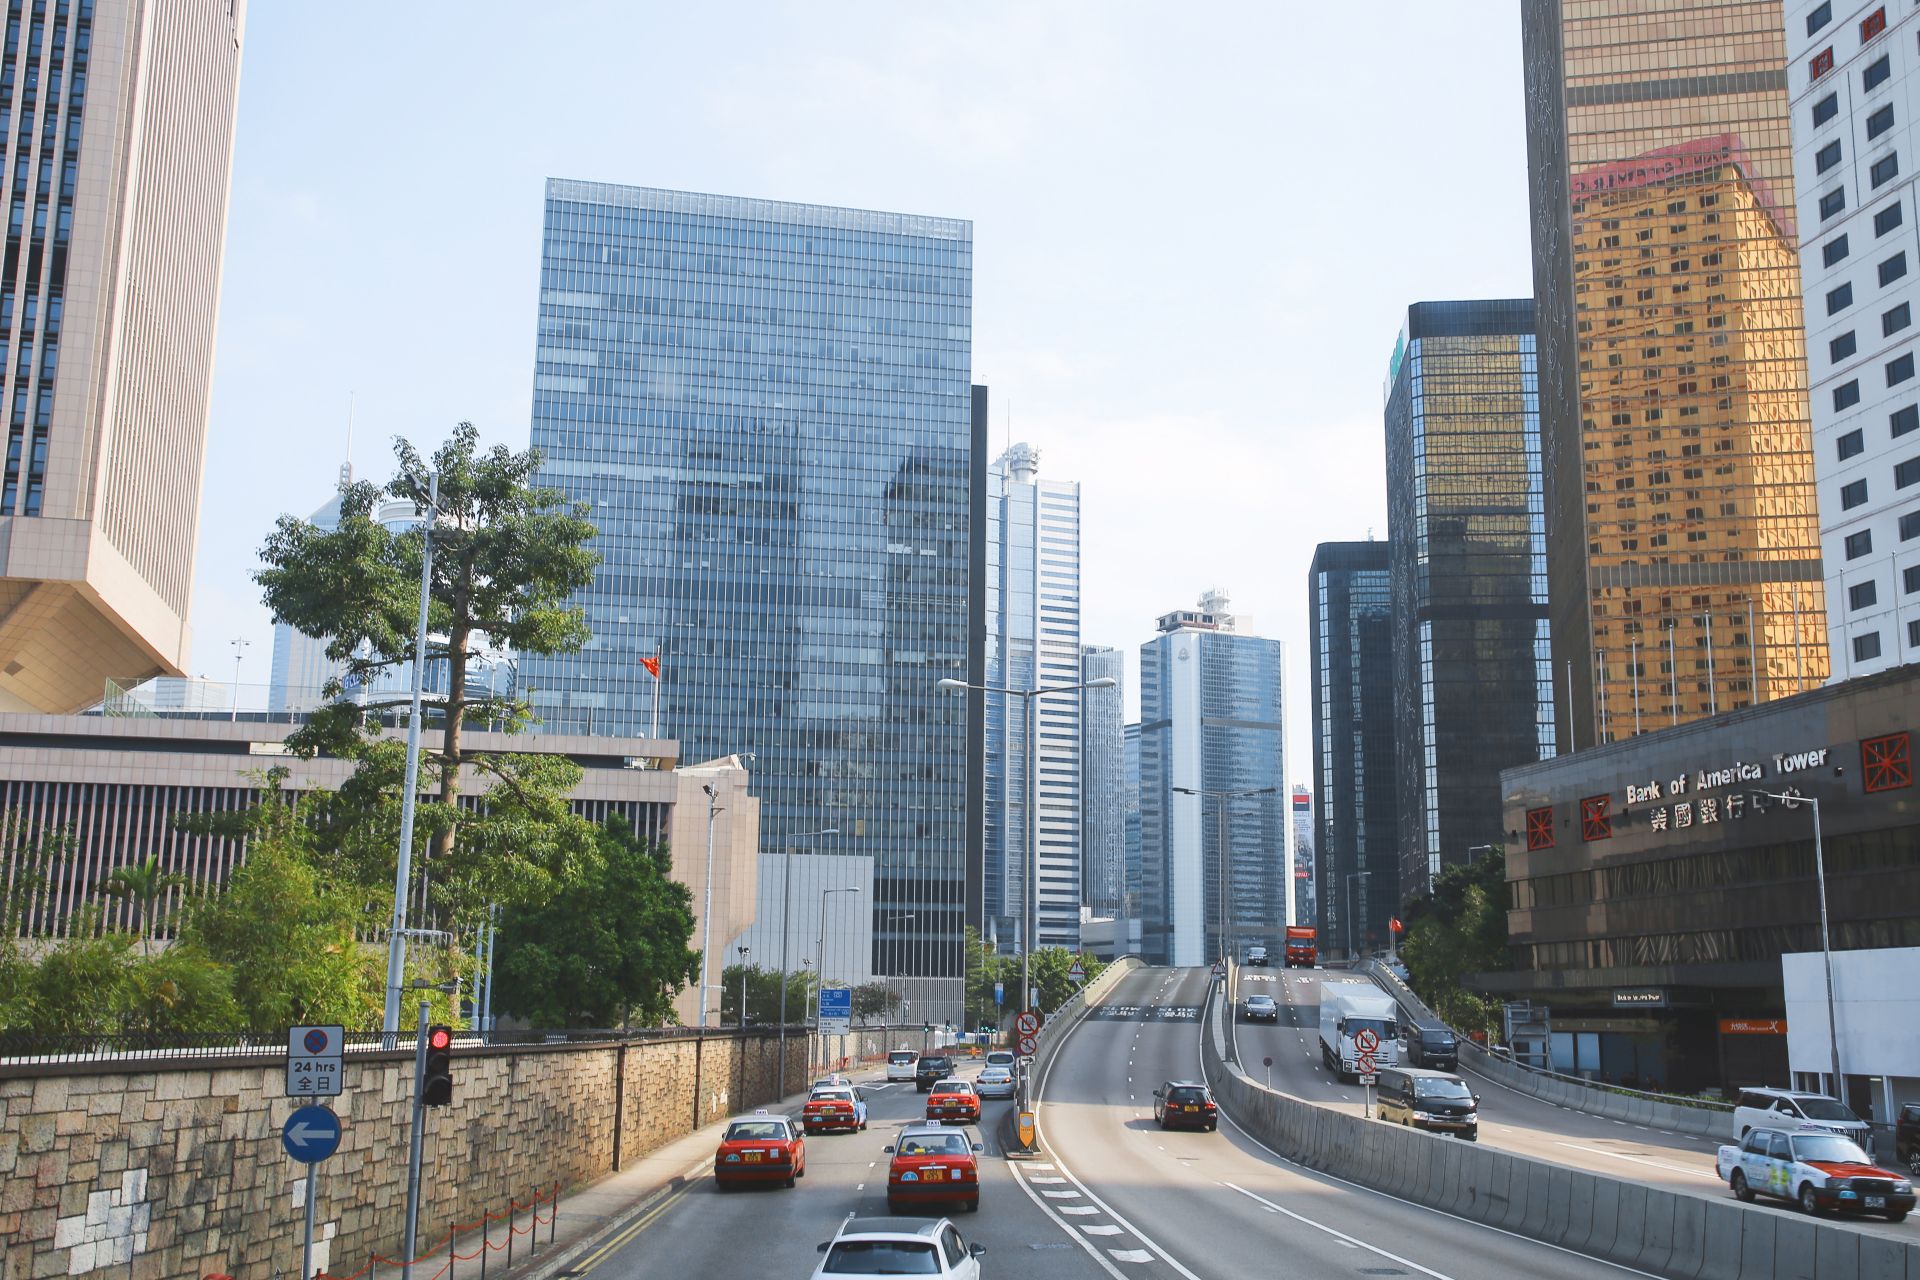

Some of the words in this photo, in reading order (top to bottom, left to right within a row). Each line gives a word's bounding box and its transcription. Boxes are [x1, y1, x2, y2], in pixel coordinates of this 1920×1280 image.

[1627, 780, 1661, 804] Bank
[1670, 773, 1686, 795] of
[1696, 761, 1762, 791] America
[1772, 748, 1827, 775] Tower
[1651, 785, 1801, 833] 美國銀行中心
[295, 1062, 312, 1072] 24
[316, 1062, 335, 1072] hrs
[297, 1076, 330, 1091] 全日
